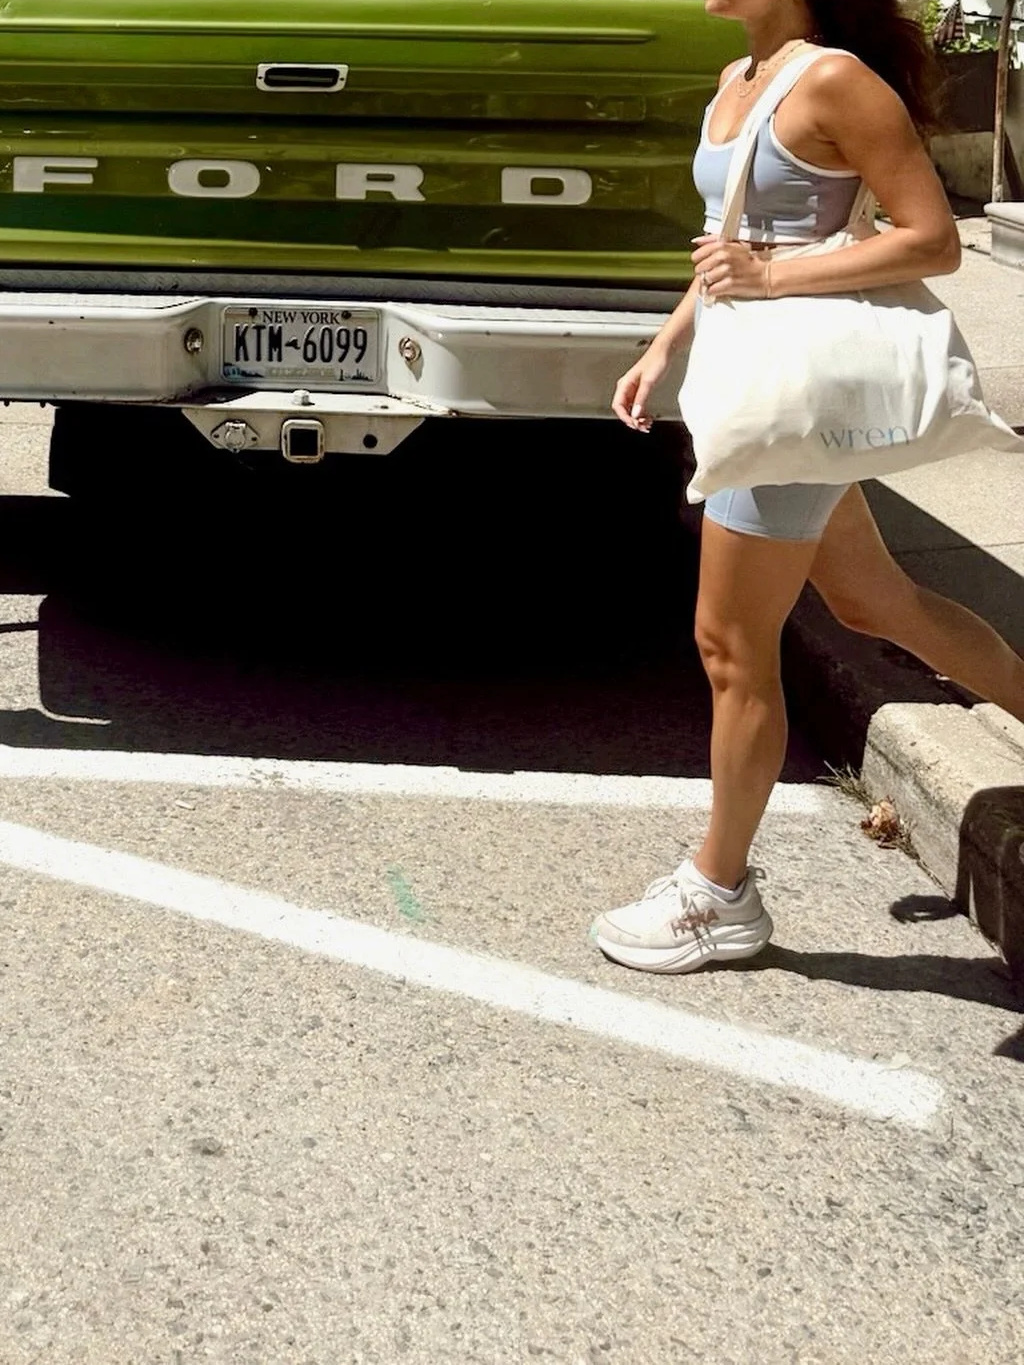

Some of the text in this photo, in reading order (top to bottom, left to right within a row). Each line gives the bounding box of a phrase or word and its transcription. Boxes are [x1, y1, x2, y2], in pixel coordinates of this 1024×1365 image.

[12, 156, 593, 205] FORD
[262, 310, 341, 325] NEW YORK
[819, 425, 911, 449] wren
